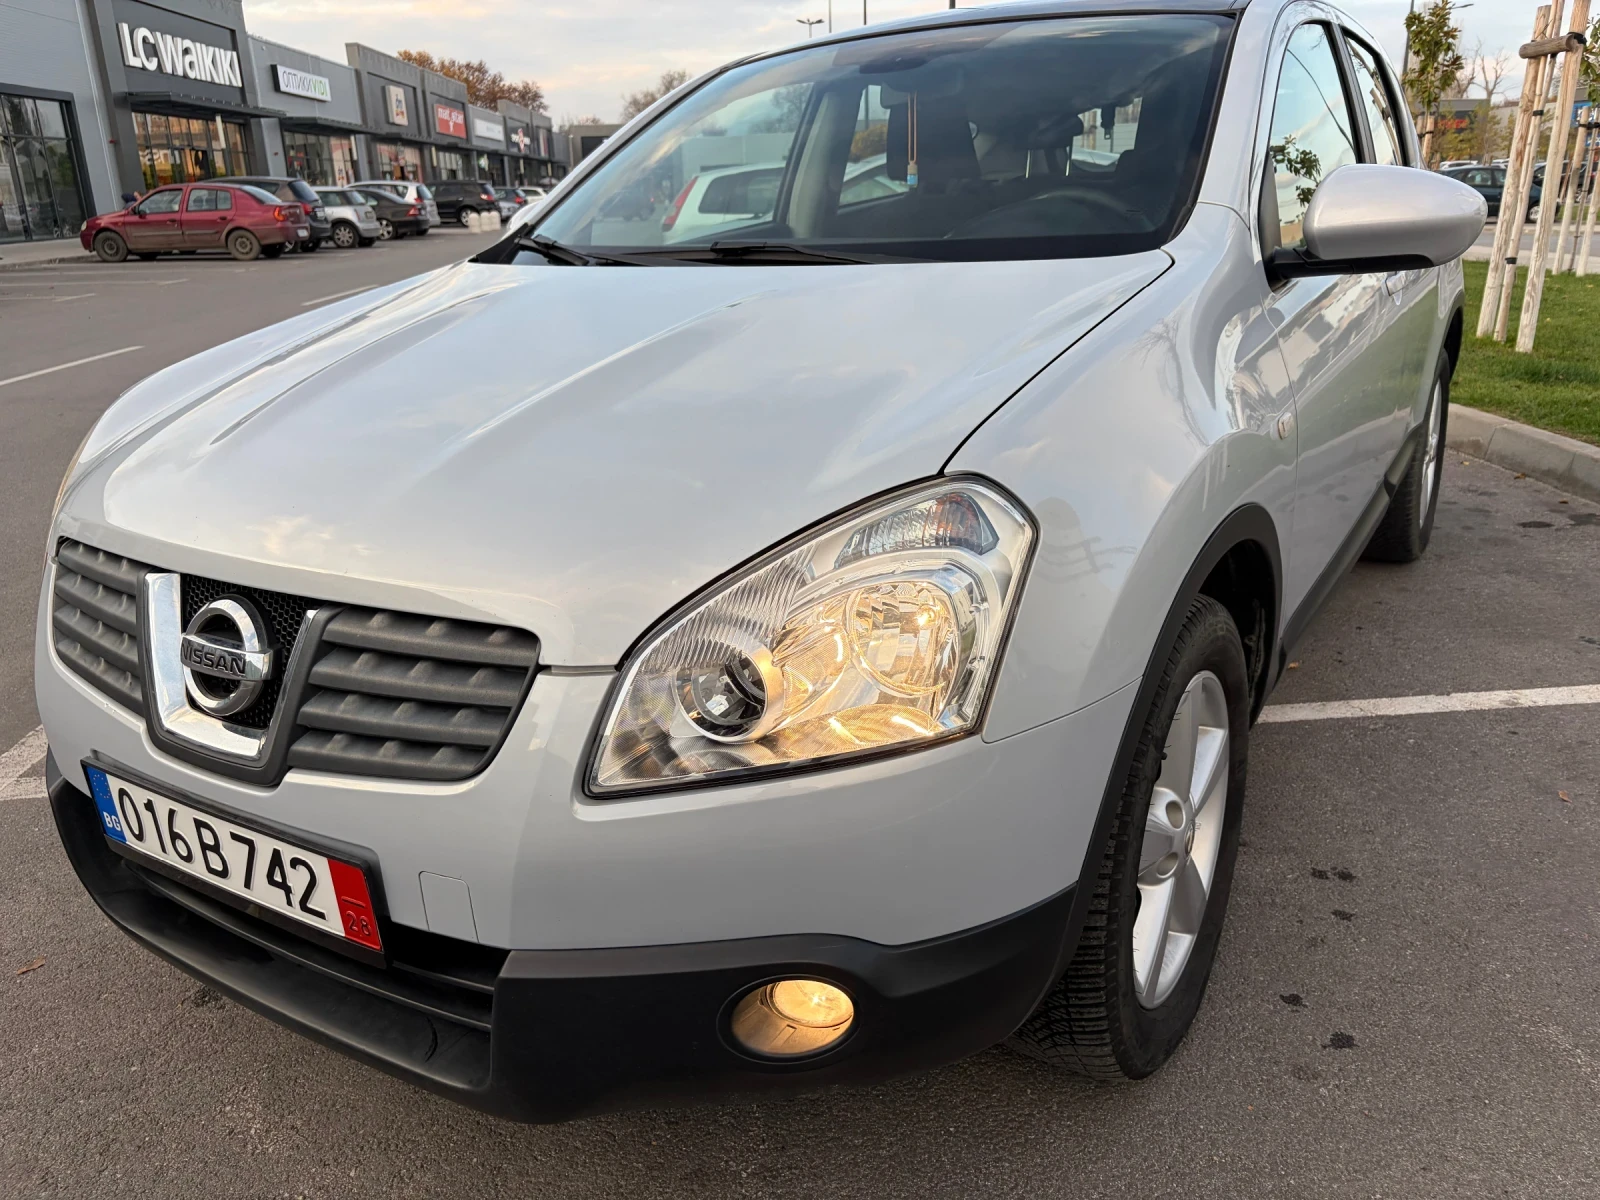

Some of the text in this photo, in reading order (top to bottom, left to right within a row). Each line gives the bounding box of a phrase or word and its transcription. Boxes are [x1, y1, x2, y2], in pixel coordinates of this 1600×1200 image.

[181, 642, 247, 676] NISSAN
[103, 810, 122, 831] BG
[345, 910, 372, 937] 28
